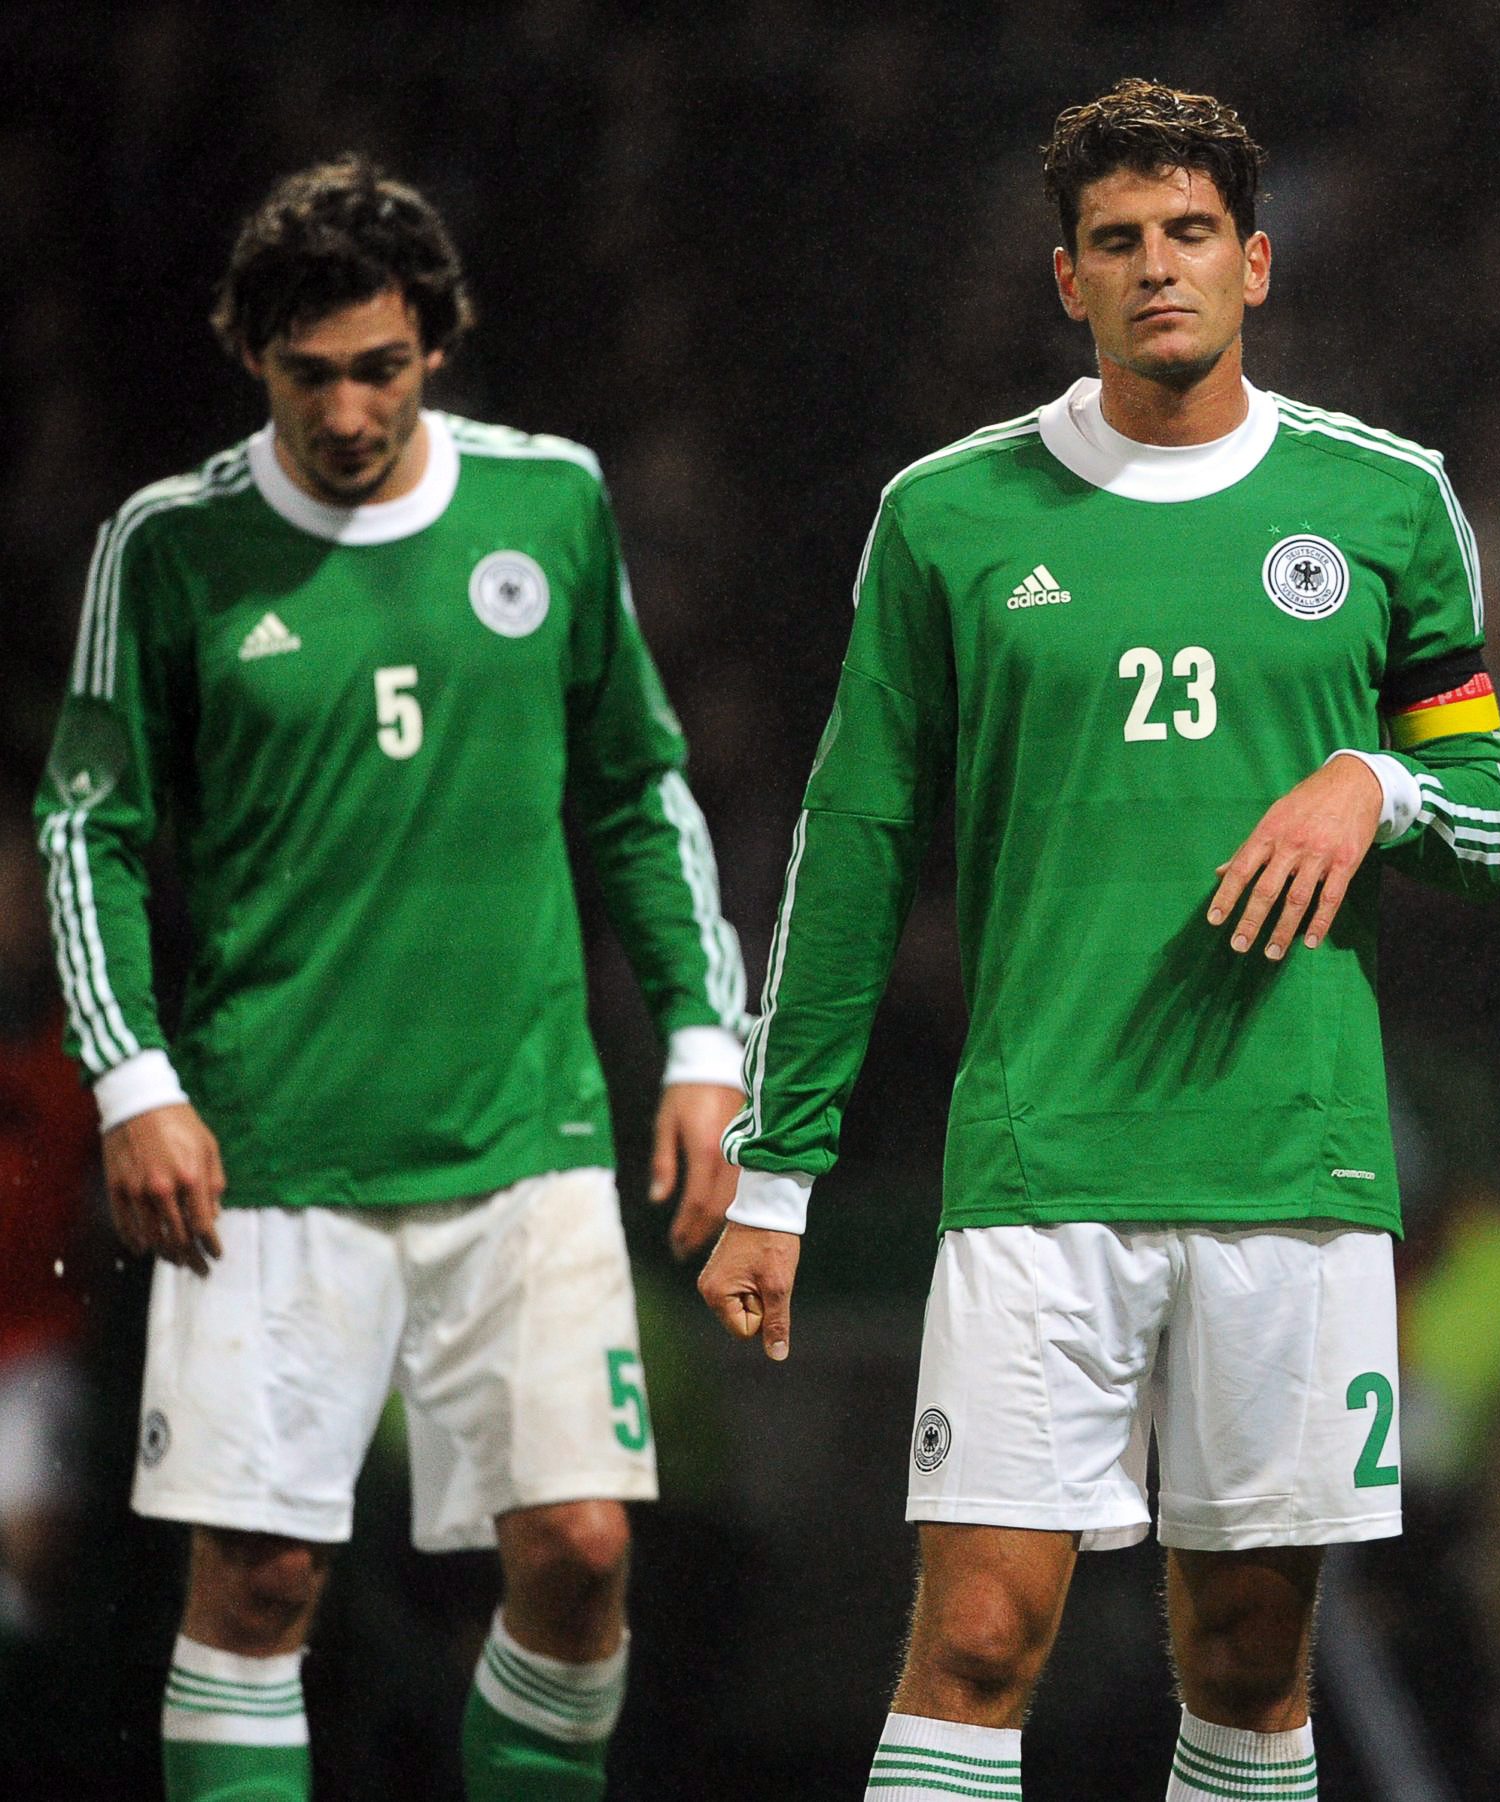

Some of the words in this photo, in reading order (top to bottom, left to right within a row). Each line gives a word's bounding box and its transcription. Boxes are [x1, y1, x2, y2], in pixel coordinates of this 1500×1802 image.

[1006, 589, 1072, 610] adidas
[374, 665, 423, 760] 5
[1118, 645, 1218, 743] 23
[607, 1349, 648, 1450] 5
[1346, 1371, 1400, 1489] 2
